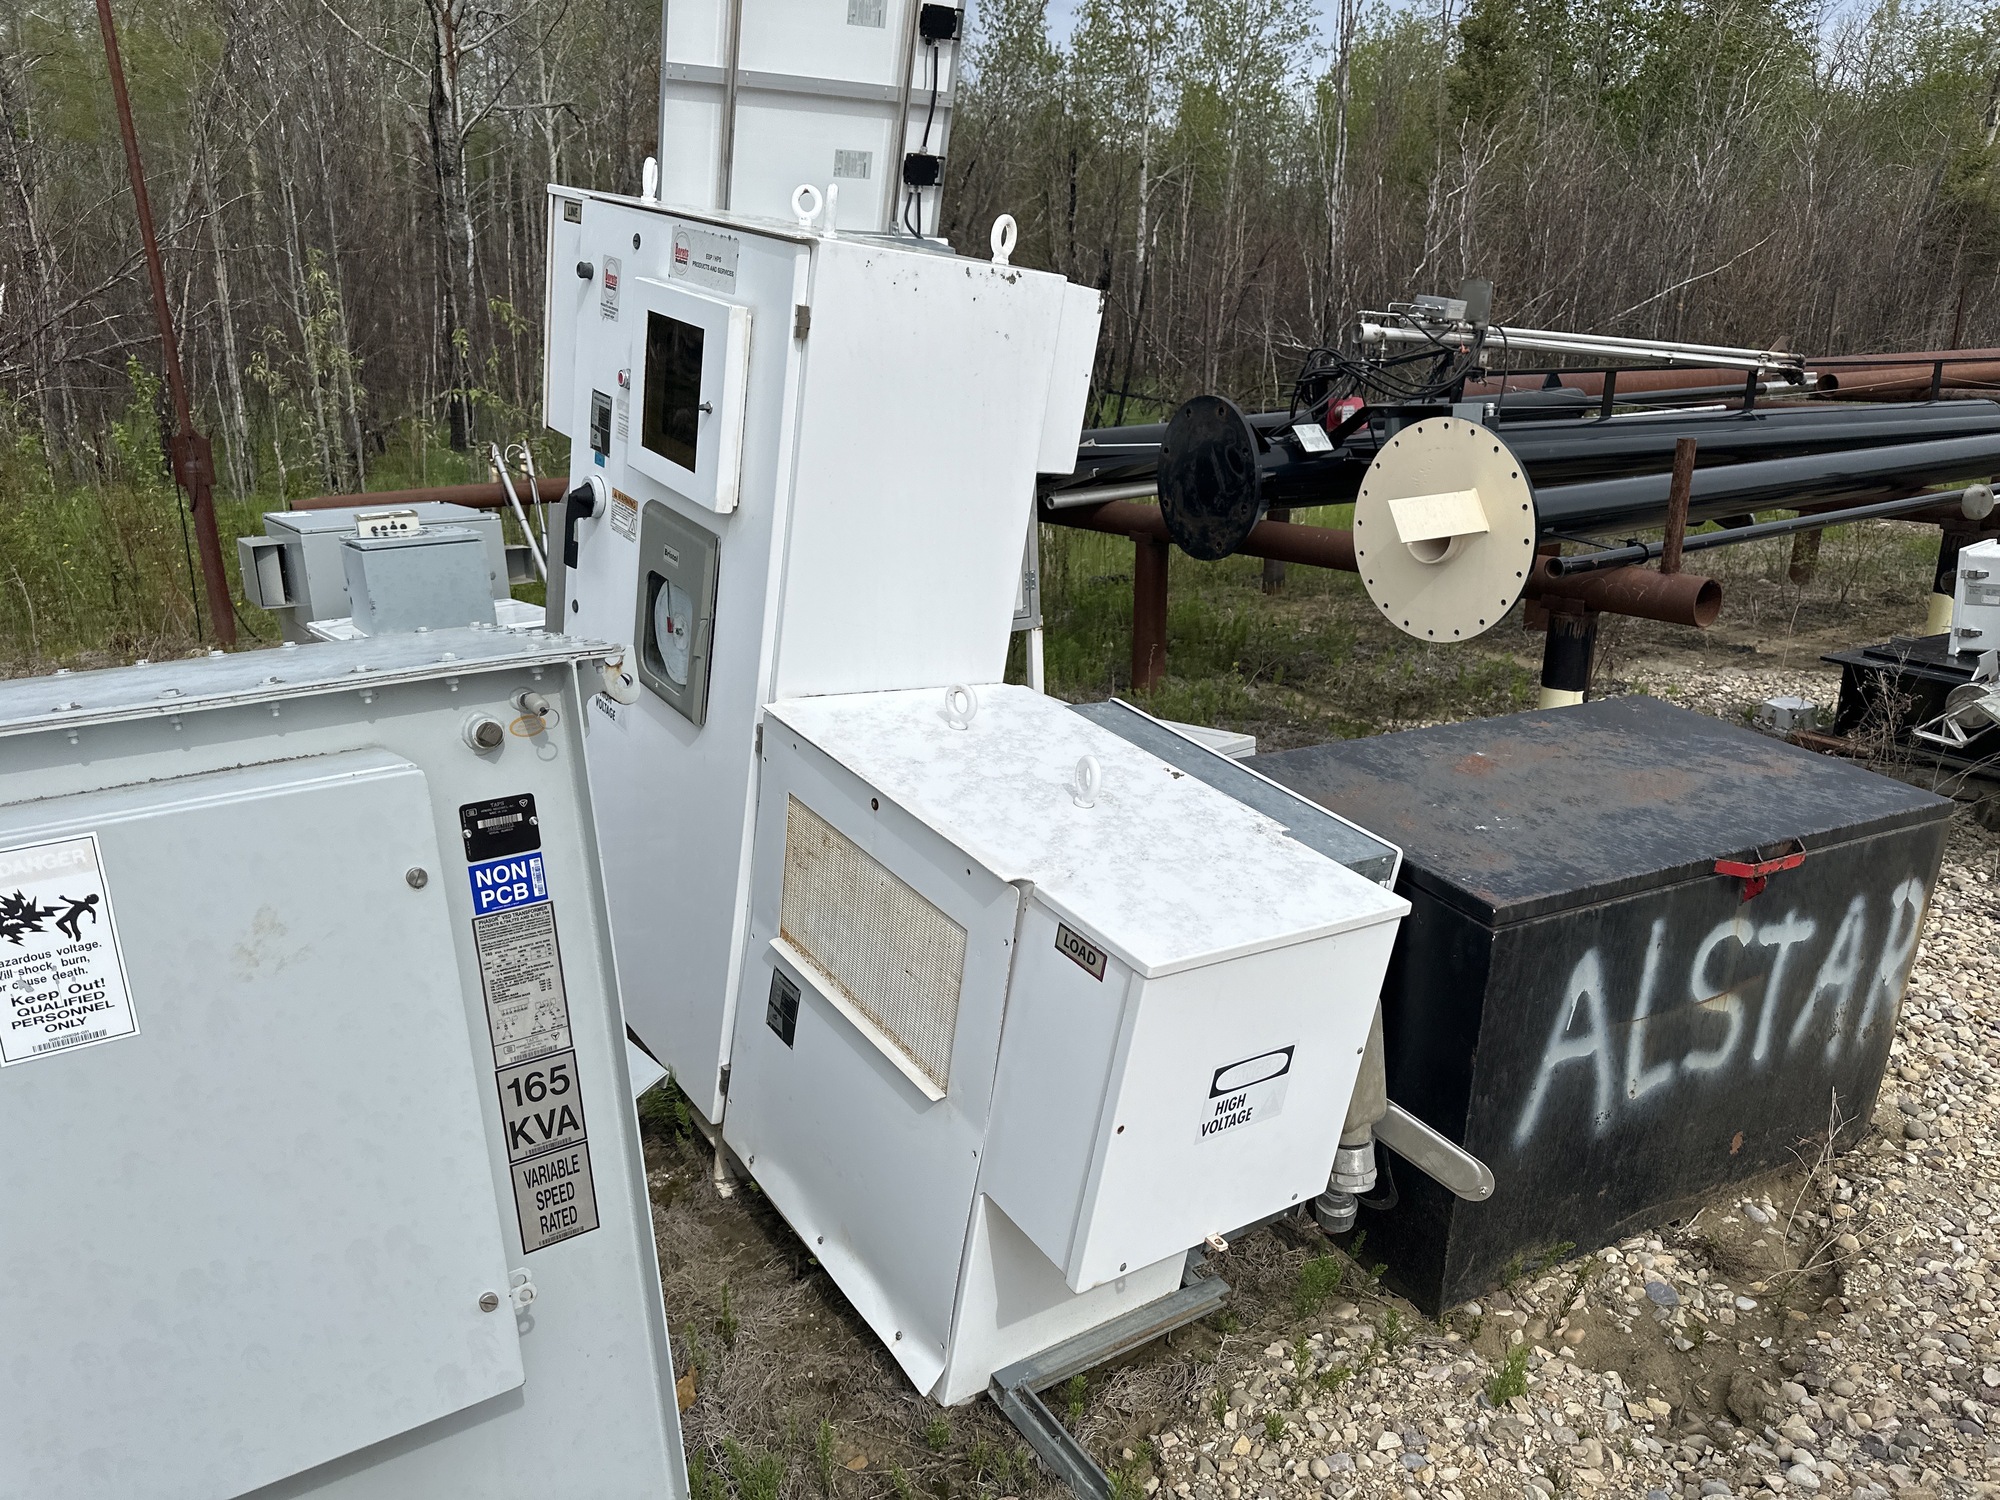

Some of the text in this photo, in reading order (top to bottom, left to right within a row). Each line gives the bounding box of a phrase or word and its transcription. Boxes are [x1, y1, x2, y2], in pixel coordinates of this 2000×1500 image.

[567, 206, 578, 218] LINE
[595, 694, 616, 722] VOLTAGE
[475, 861, 528, 888] NON
[480, 882, 529, 909] PCB
[0, 941, 102, 969] azardous voltage.
[1063, 933, 1097, 966] LOAD
[0, 969, 13, 982] ill
[60, 955, 91, 967] burn,
[12, 976, 47, 990] cuse
[52, 966, 89, 981] death.
[10, 977, 106, 1007] Keep Out!
[17, 991, 105, 1017] QUALIFIED
[11, 1000, 116, 1030] PERSONNEL
[44, 1016, 87, 1033] ONLY
[507, 1063, 570, 1107] 165
[1214, 1093, 1247, 1117] HIGH
[509, 1104, 580, 1150] KVA
[1201, 1107, 1254, 1137] VOLTAGE
[523, 1154, 580, 1189] VARIABLE
[535, 1181, 575, 1211] SPEED
[539, 1205, 578, 1235] RATED
